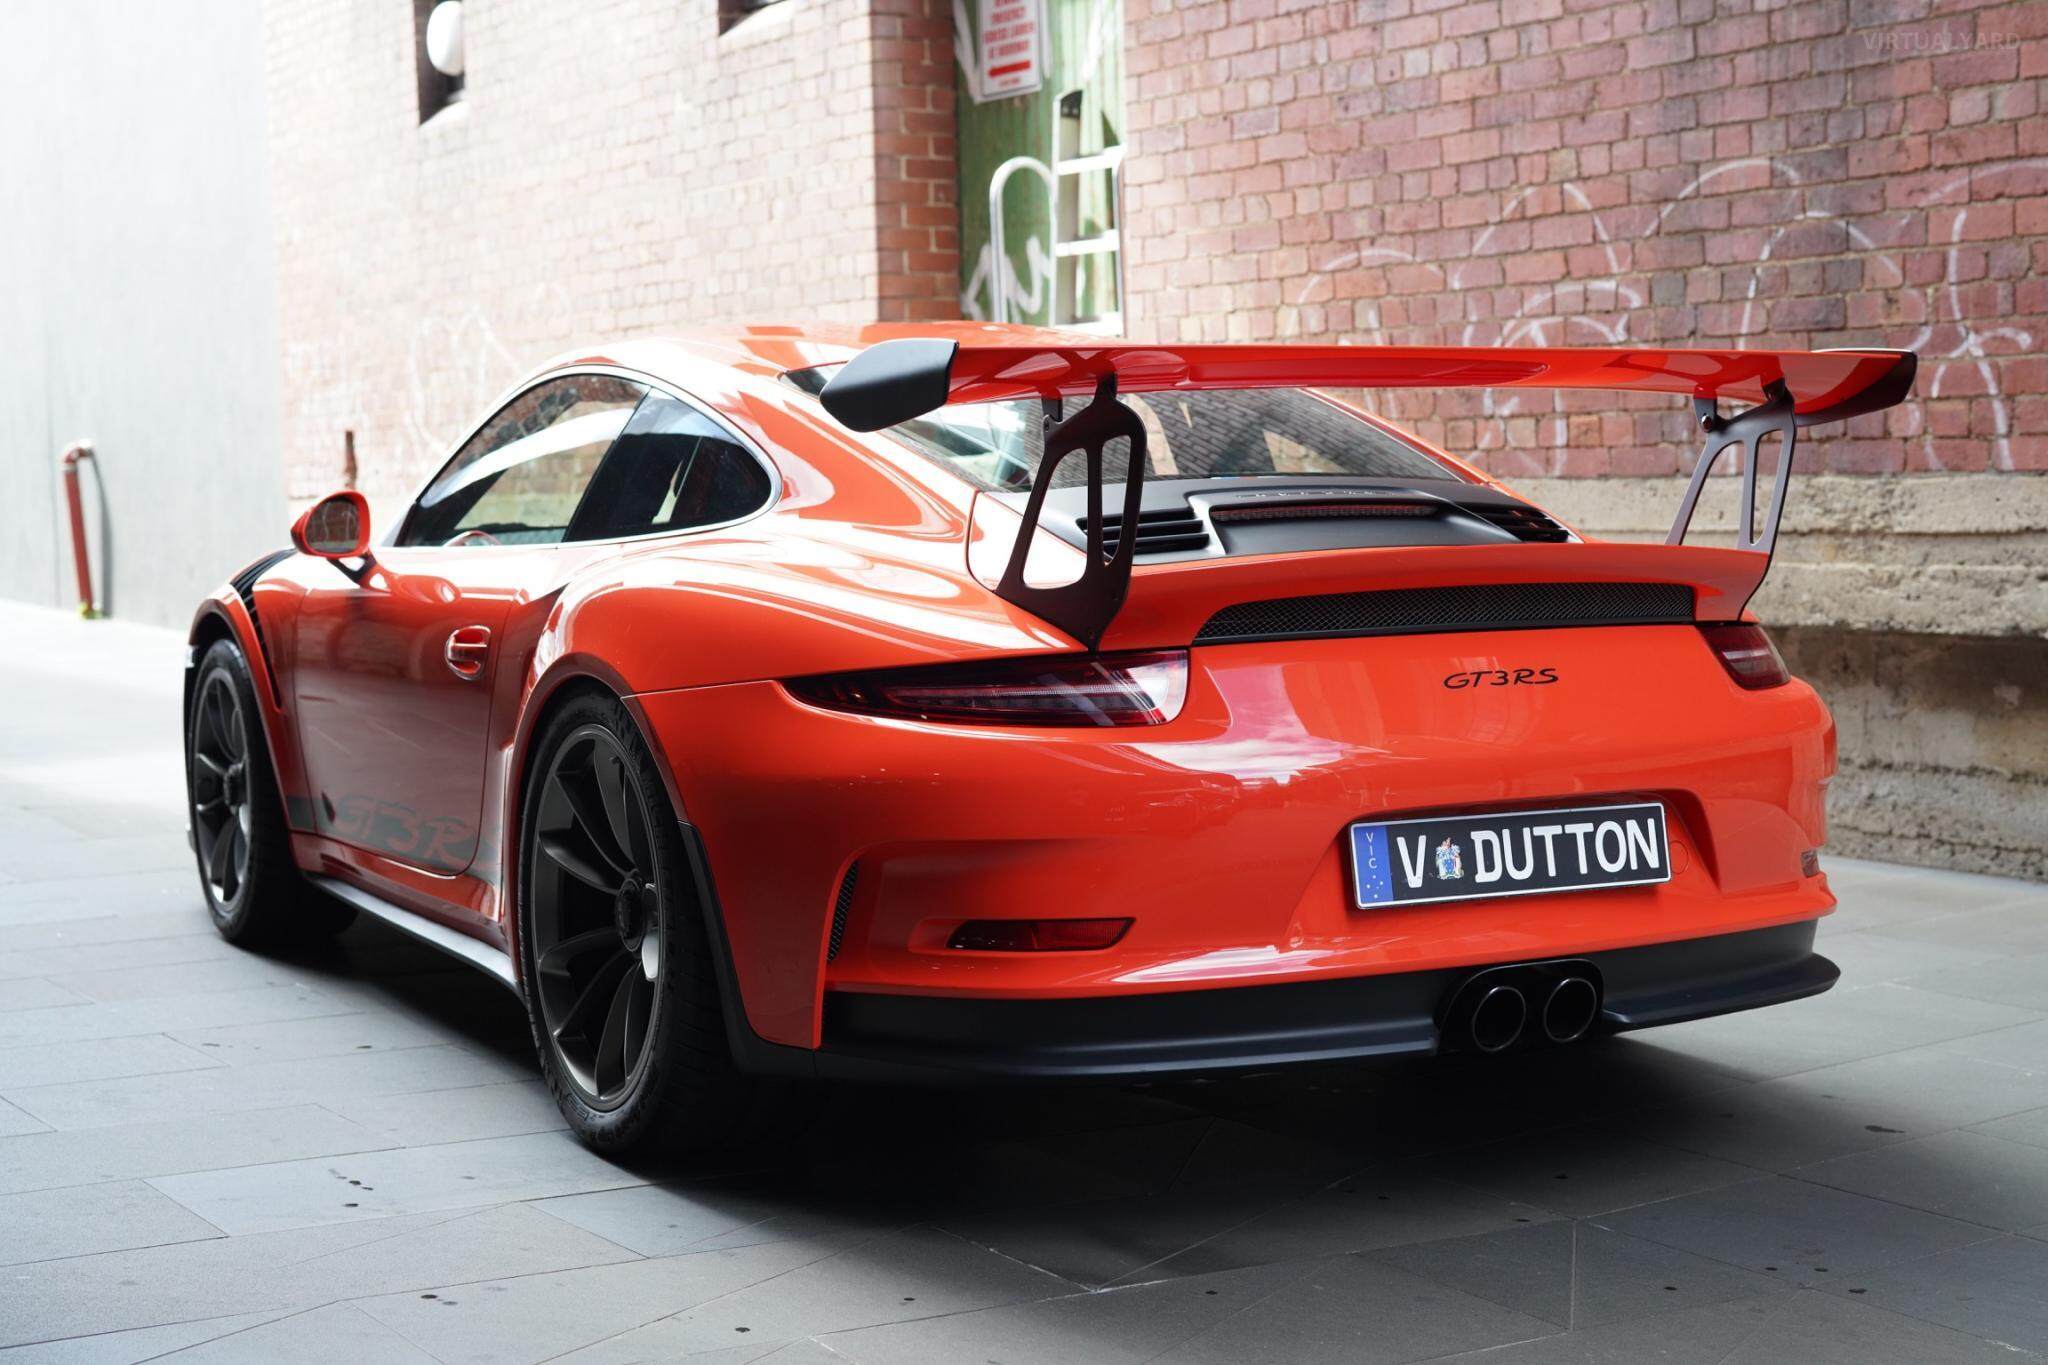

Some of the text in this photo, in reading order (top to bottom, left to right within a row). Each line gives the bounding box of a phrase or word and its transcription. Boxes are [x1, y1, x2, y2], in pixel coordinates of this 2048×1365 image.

[1366, 832, 1378, 869] VIC
[1396, 817, 1660, 888] V DUTTON
